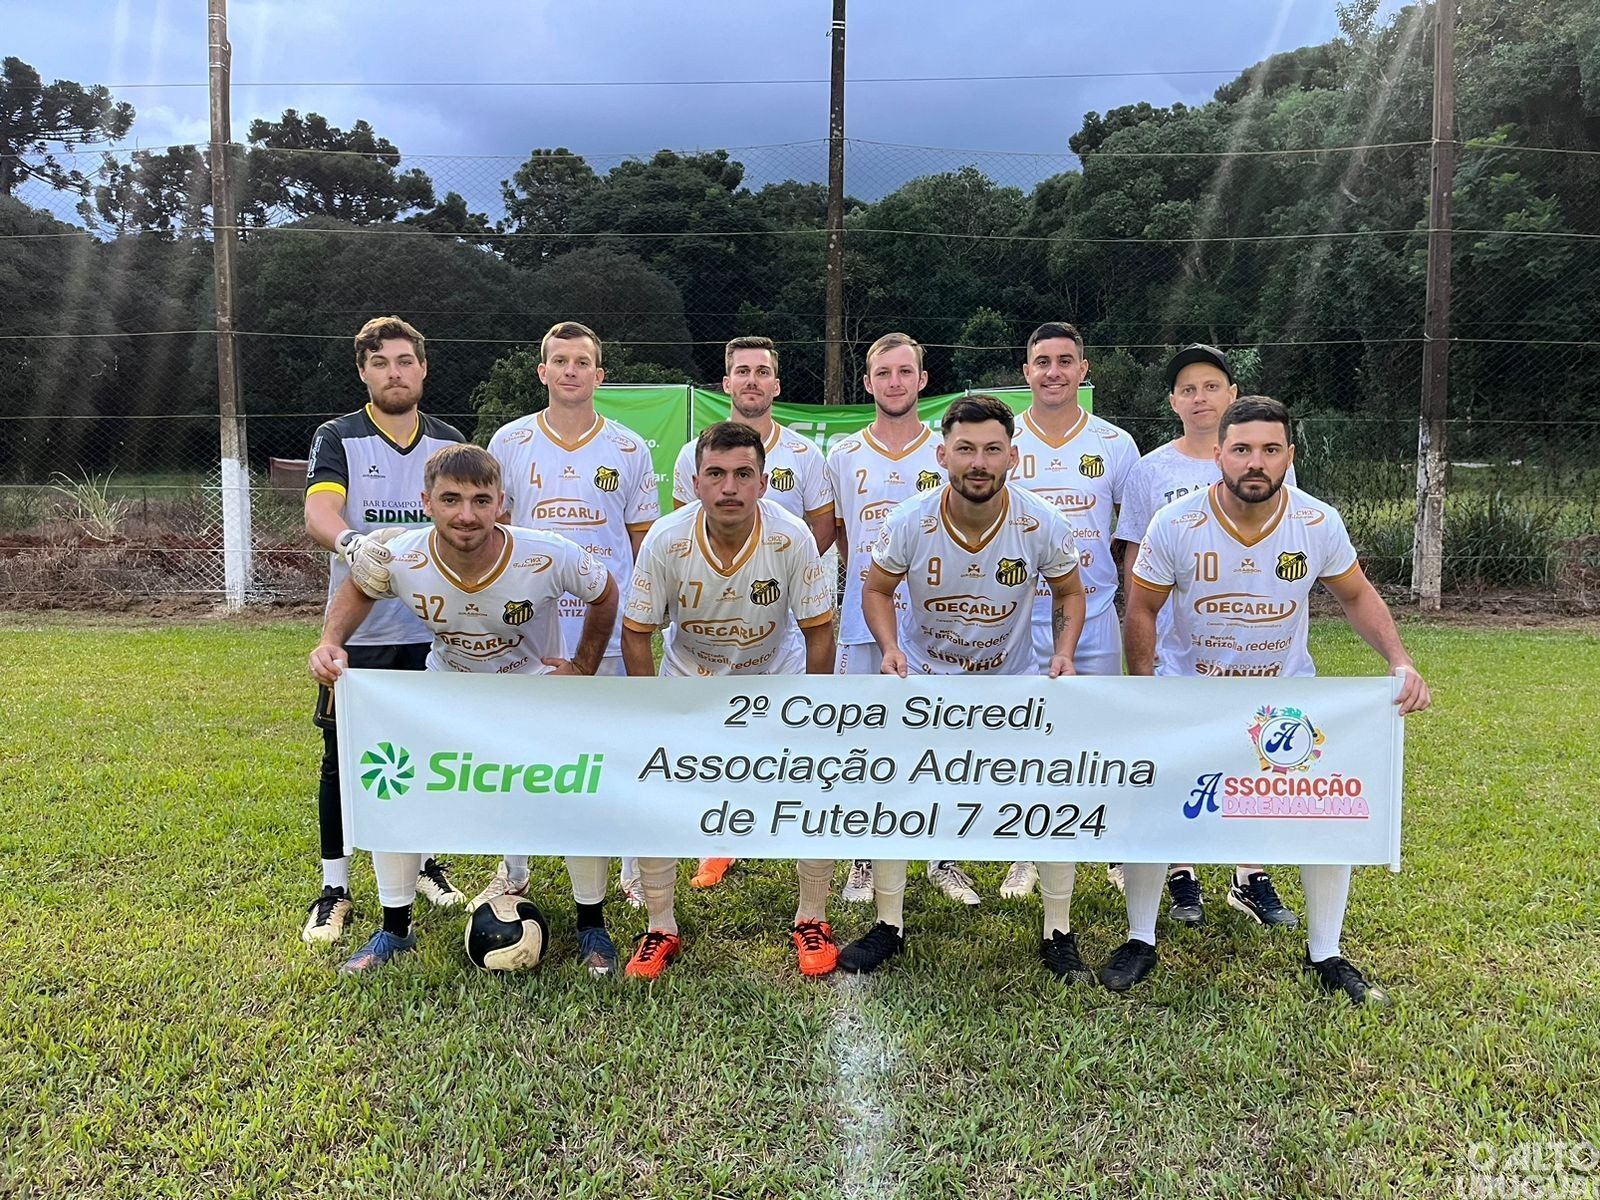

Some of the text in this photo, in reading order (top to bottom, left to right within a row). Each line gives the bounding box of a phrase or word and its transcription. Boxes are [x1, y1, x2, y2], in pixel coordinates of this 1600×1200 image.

[529, 462, 542, 489] 4
[855, 469, 868, 495] 2
[363, 500, 380, 508] BAR
[1042, 494, 1089, 506] CARLI
[365, 509, 431, 523] SIDINH
[536, 506, 600, 520] DECARLI
[1072, 528, 1101, 538] defort
[927, 557, 941, 586] 9
[1194, 551, 1218, 582] 10
[678, 581, 703, 609] 47
[412, 593, 447, 624] 32
[935, 602, 1006, 617] DECARLI
[1206, 602, 1284, 615] DECARLI
[692, 624, 764, 640] DECARLI
[440, 635, 513, 651] DECARLI
[1205, 640, 1243, 652] Brizolla
[1245, 636, 1292, 652] redefort
[496, 657, 529, 674] defort
[780, 695, 887, 735] Copa
[901, 695, 1054, 734] Sicredi,
[426, 751, 604, 794] Sicredi
[638, 747, 1156, 791] Associação Adrenalina
[700, 801, 1107, 838] de Futebol 7 2024
